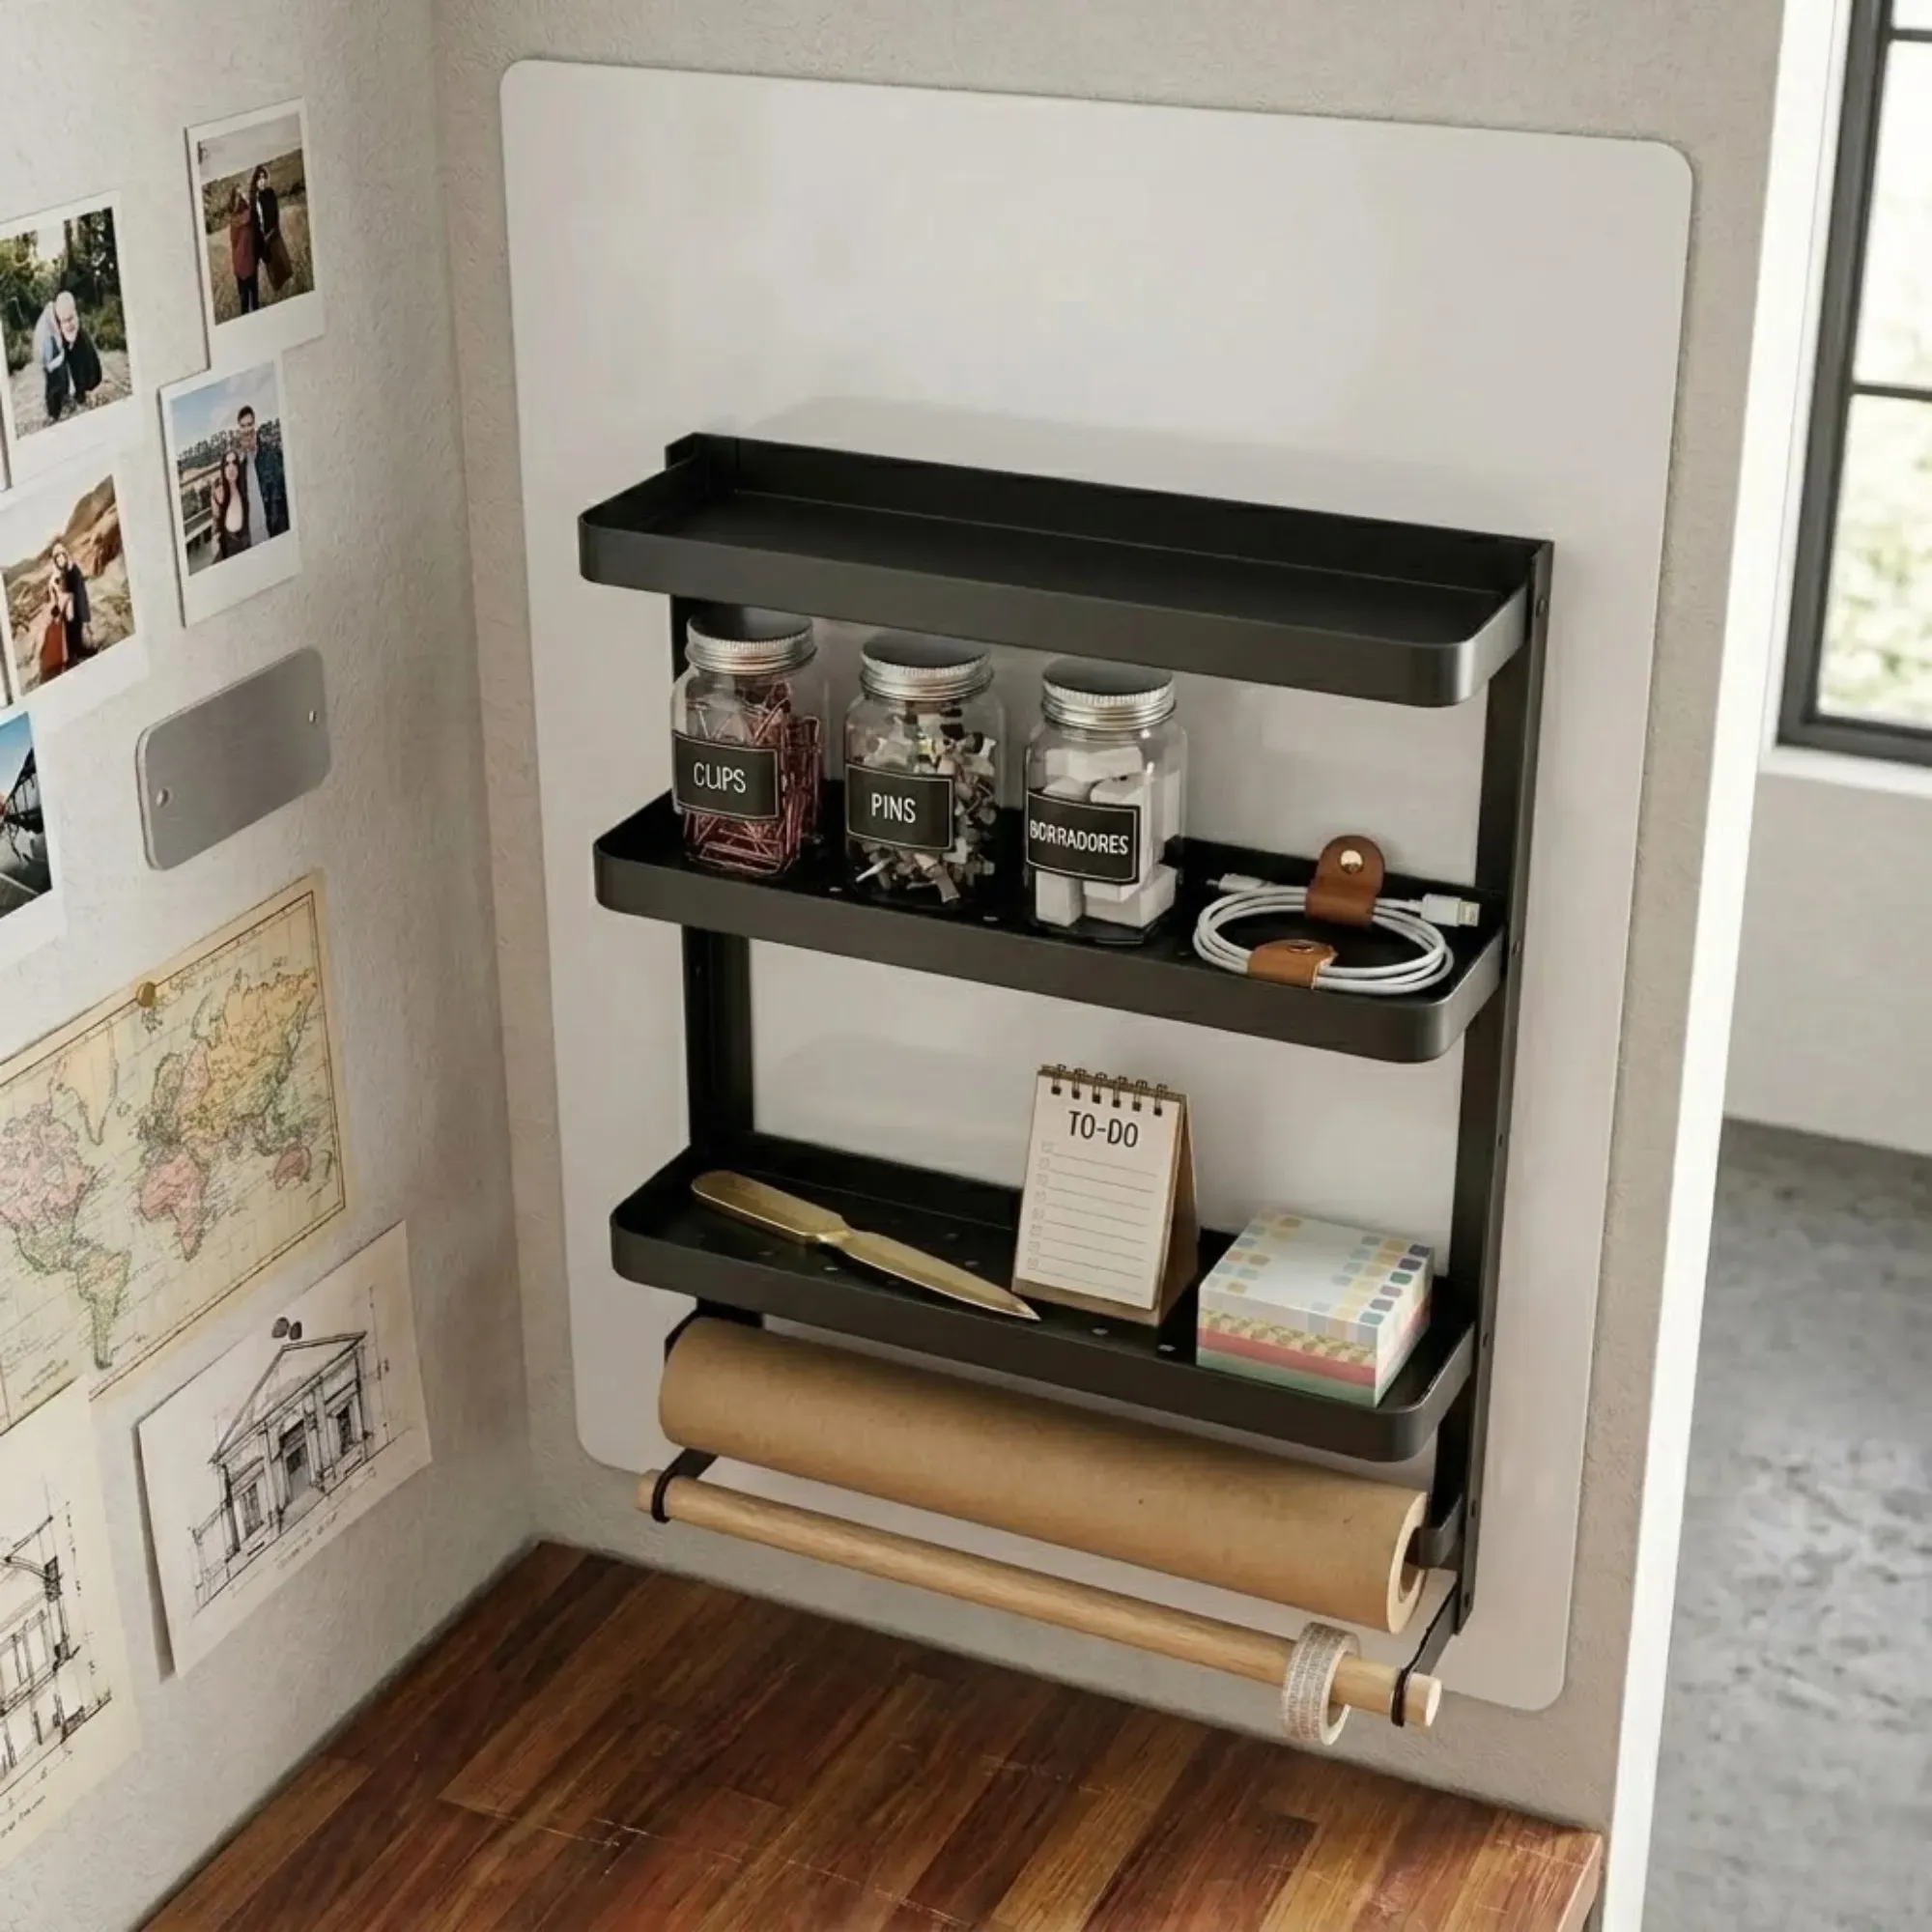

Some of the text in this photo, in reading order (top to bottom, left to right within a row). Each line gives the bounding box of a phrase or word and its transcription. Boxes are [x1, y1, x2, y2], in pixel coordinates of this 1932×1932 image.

[871, 792, 917, 823] PINS
[1029, 819, 1129, 855] BORRADORES
[1068, 1110, 1139, 1148] TO-DO
